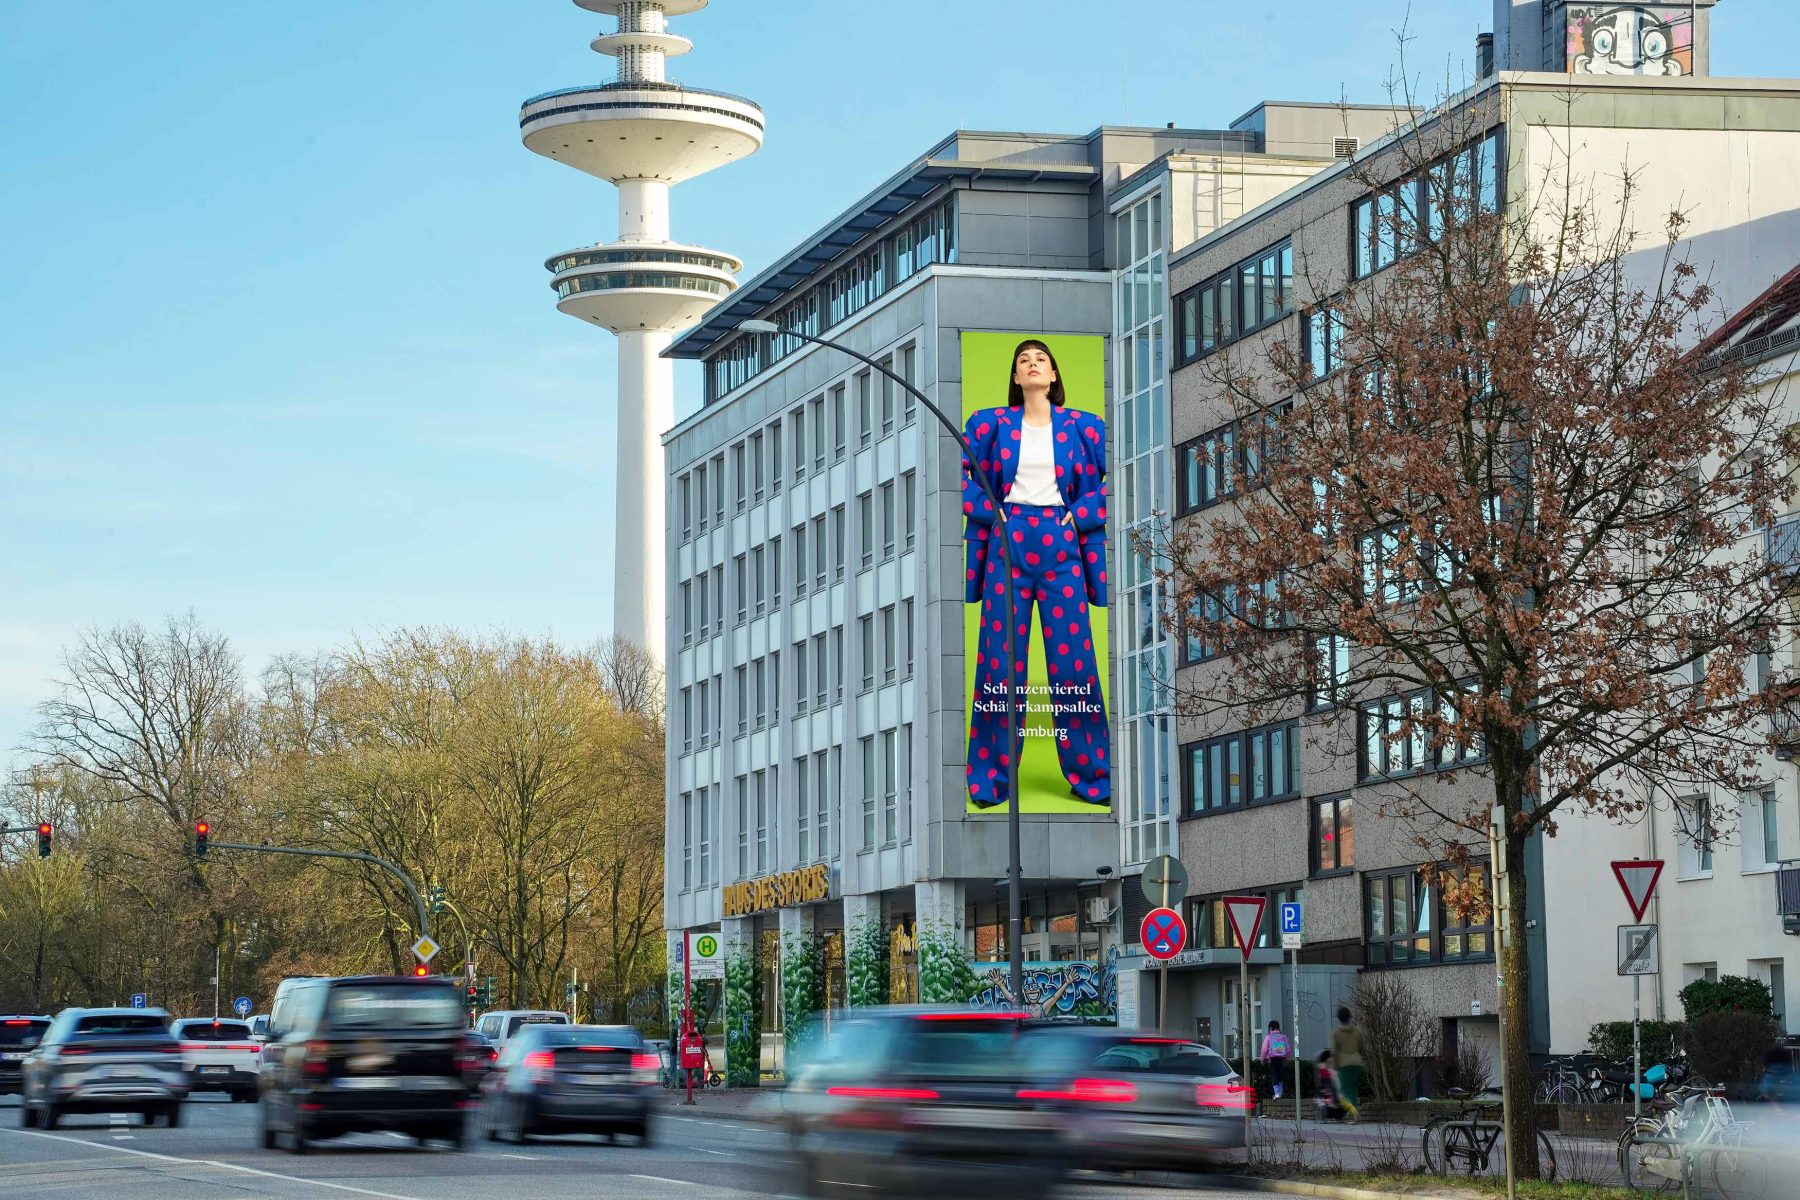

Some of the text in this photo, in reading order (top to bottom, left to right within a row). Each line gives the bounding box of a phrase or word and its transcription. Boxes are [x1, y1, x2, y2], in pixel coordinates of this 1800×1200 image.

[983, 682, 1091, 695] Schnzenviertel
[1016, 725, 1068, 740] amburg
[723, 863, 829, 917] HAUS DES SPORTS
[1284, 906, 1296, 930] P
[702, 941, 712, 952] H
[135, 996, 142, 1008] P
